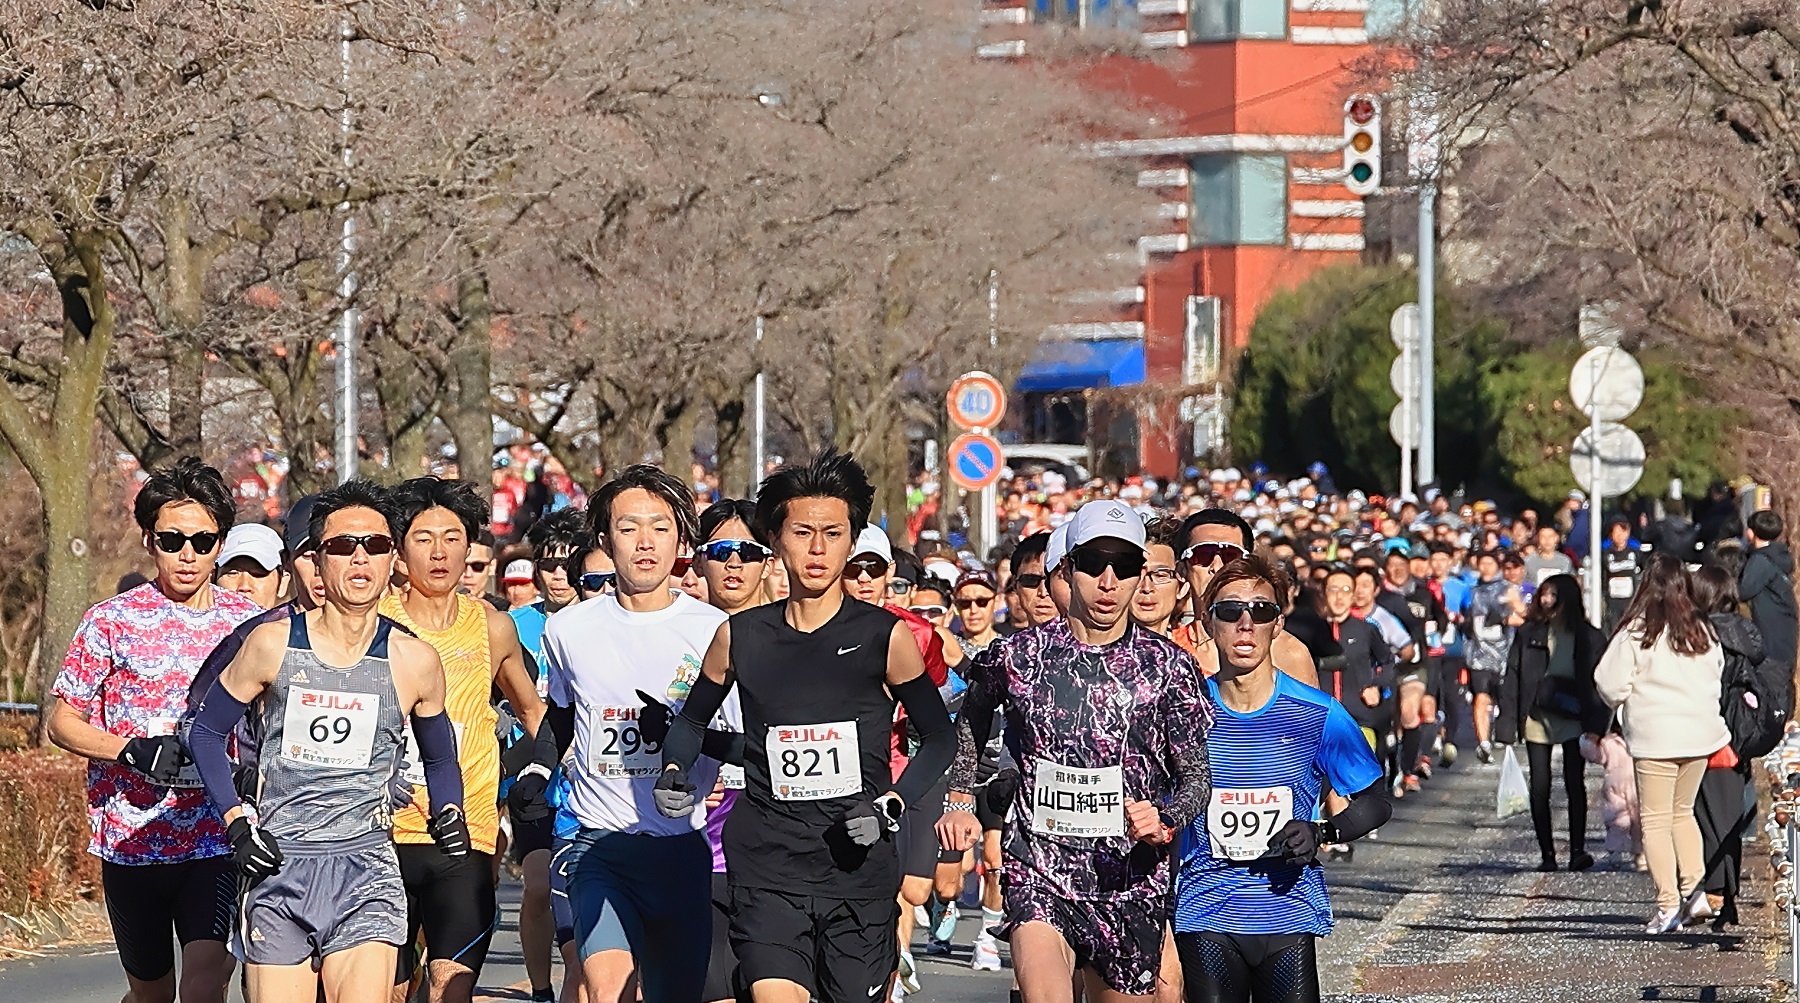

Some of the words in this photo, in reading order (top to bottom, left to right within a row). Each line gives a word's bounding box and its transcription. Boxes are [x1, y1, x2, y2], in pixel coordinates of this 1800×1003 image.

[961, 389, 993, 415] 40
[301, 693, 364, 711] きりしん
[603, 707, 640, 721] きりし
[309, 715, 352, 744] 69
[778, 728, 843, 743] きりしん
[781, 747, 840, 778] 821
[1055, 770, 1101, 785] 招待選手
[1037, 785, 1120, 814] 山口純平
[1220, 791, 1281, 805] きりしん
[1221, 809, 1281, 838] 997
